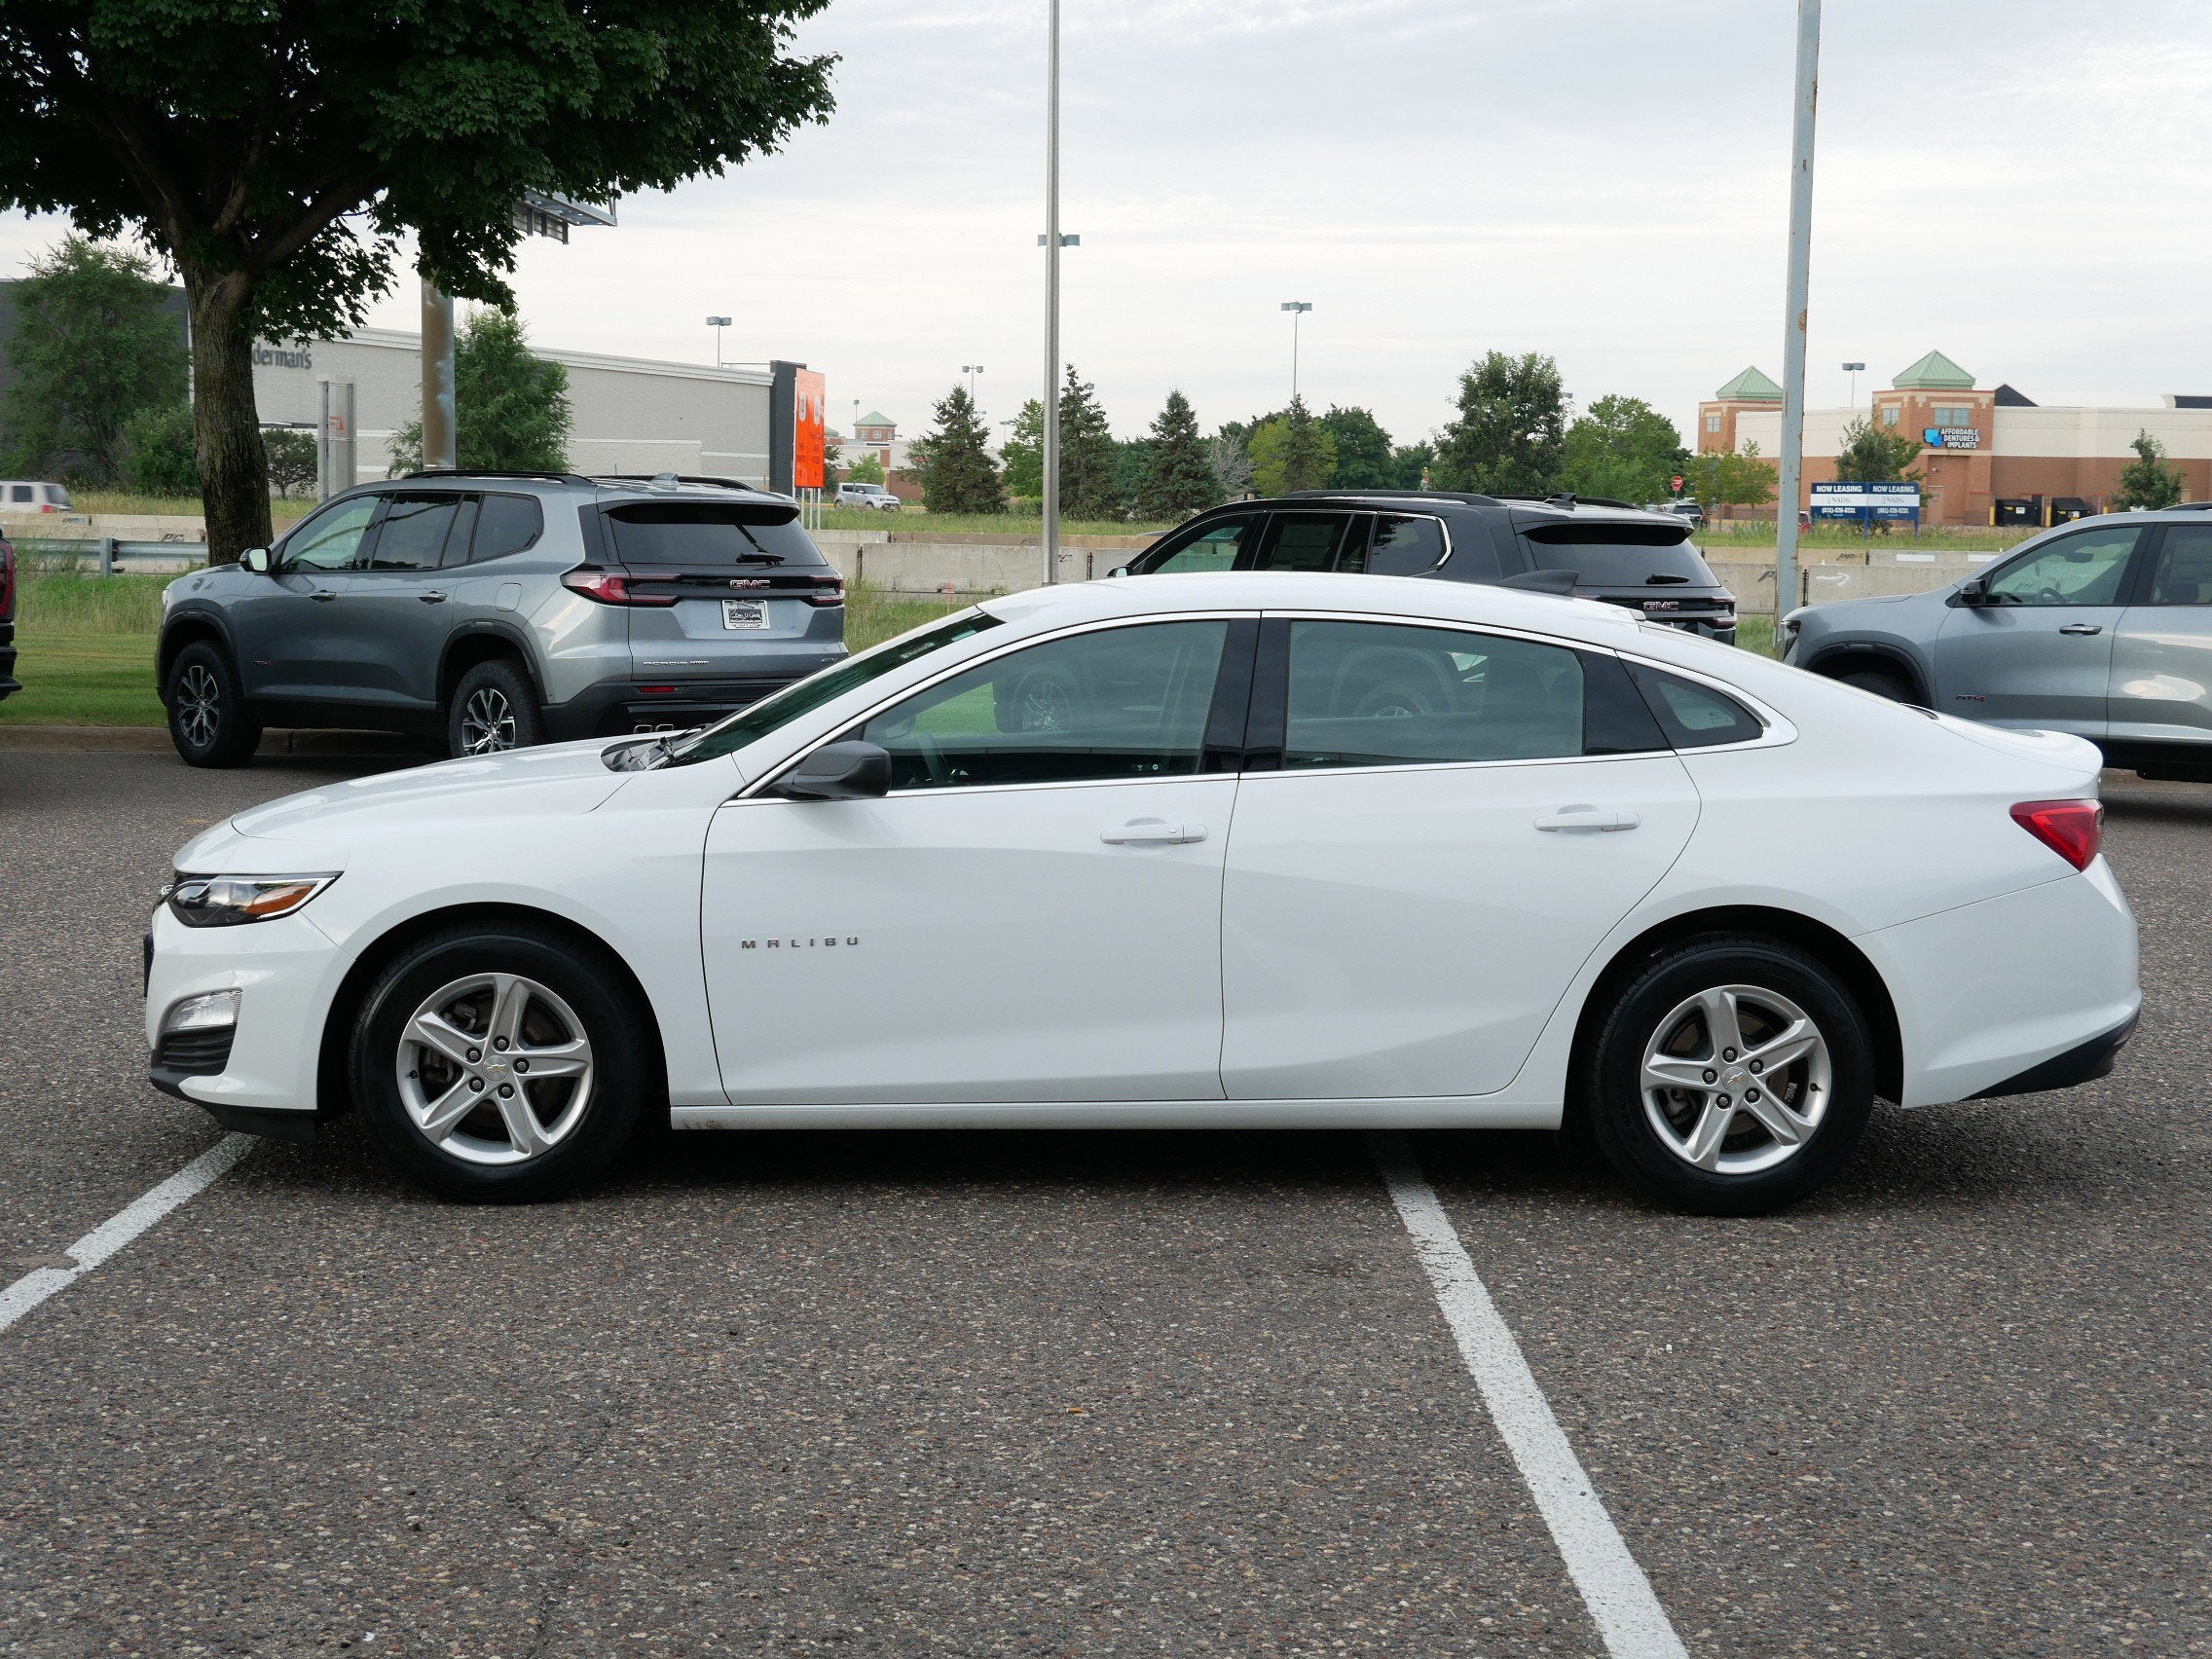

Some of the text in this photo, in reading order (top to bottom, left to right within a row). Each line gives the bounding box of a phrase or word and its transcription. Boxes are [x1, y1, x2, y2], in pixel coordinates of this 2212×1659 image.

[729, 579, 771, 590] GMC
[1643, 601, 1679, 610] GMC
[740, 936, 858, 949] MALIBU
